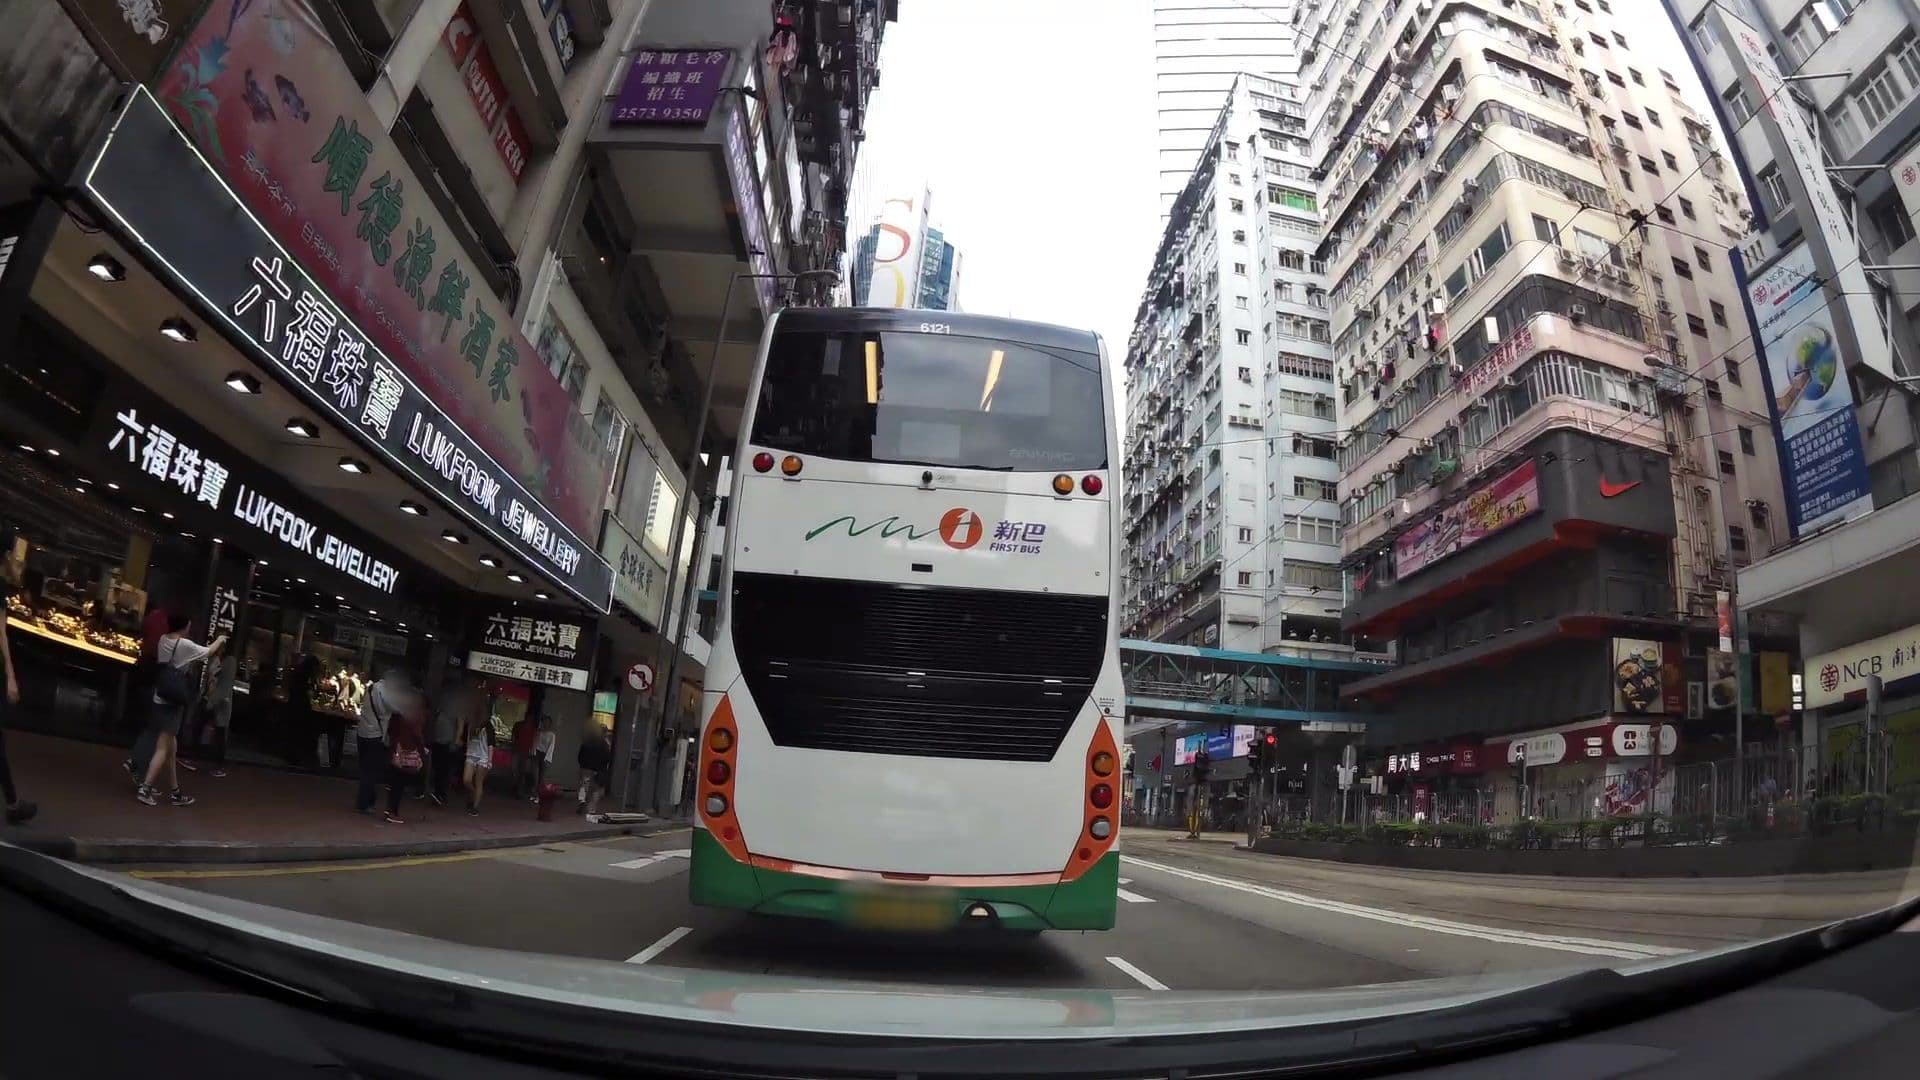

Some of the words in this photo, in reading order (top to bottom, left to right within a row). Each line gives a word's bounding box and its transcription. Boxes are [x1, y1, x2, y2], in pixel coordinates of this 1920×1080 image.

[647, 87, 686, 101] 招生
[618, 108, 657, 119] 2573
[663, 108, 702, 119] 9350
[920, 323, 951, 335] 6121
[234, 256, 404, 440] 六福珠寶
[108, 408, 229, 511] 六福珠寶
[406, 411, 501, 516] LUKFOOK
[501, 498, 582, 577] JEWELLERY
[233, 484, 318, 555] LUKFOOK
[316, 533, 400, 595] JEWELLERY
[993, 520, 1047, 543] 新巴
[989, 542, 1019, 554] FIRST
[1020, 544, 1041, 555] BUS
[486, 611, 582, 650] 六福珠寶
[484, 636, 522, 651] LUKFOOK
[525, 644, 577, 660] JEWELLERY
[520, 664, 574, 686] 六福珠寶
[1843, 655, 1883, 683] NCB
